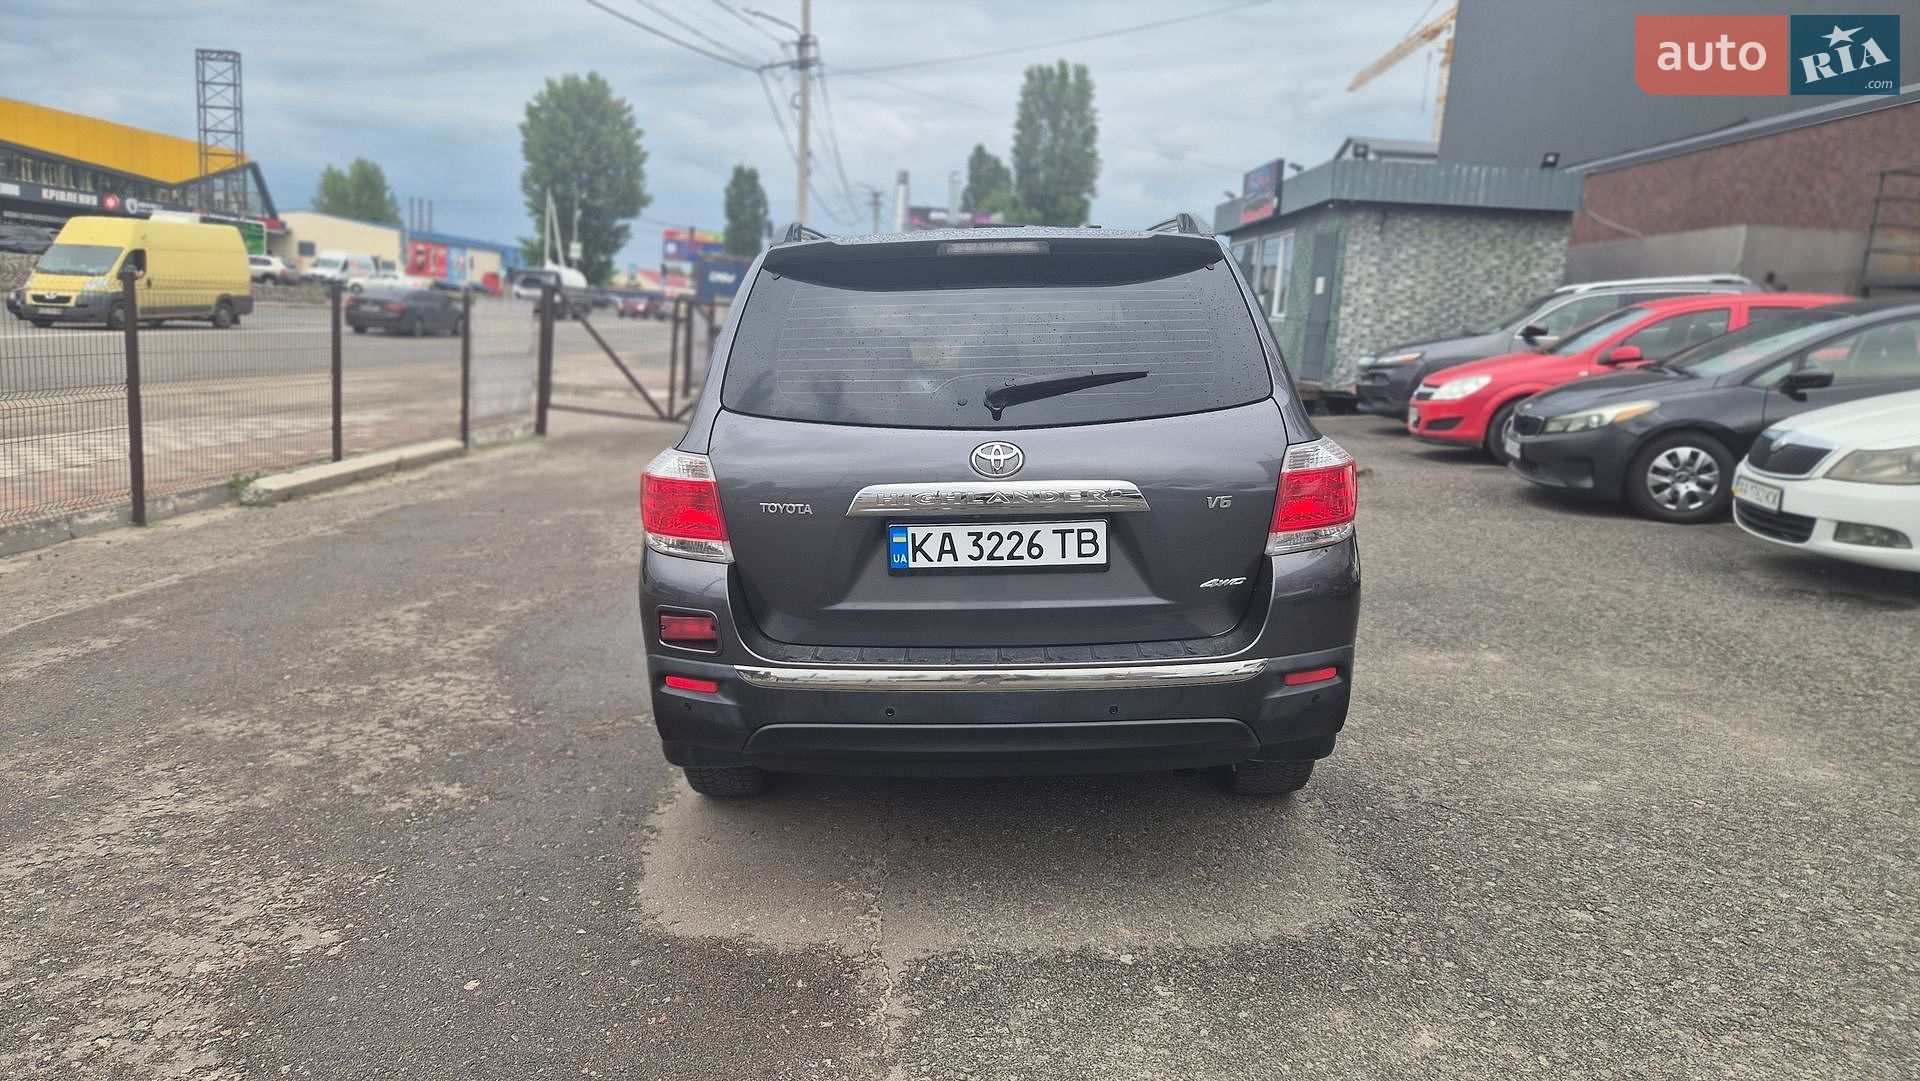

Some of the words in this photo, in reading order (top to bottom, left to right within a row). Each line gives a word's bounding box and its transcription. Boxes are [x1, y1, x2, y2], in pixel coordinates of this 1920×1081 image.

[876, 489, 1110, 506] HIGHLANDER
[1206, 495, 1233, 509] V6
[760, 502, 813, 515] TOYOTA
[910, 532, 959, 563] KA
[967, 529, 1045, 562] 3226
[1052, 529, 1100, 559] TB
[893, 553, 908, 563] UA
[1199, 577, 1247, 588] 4WD
